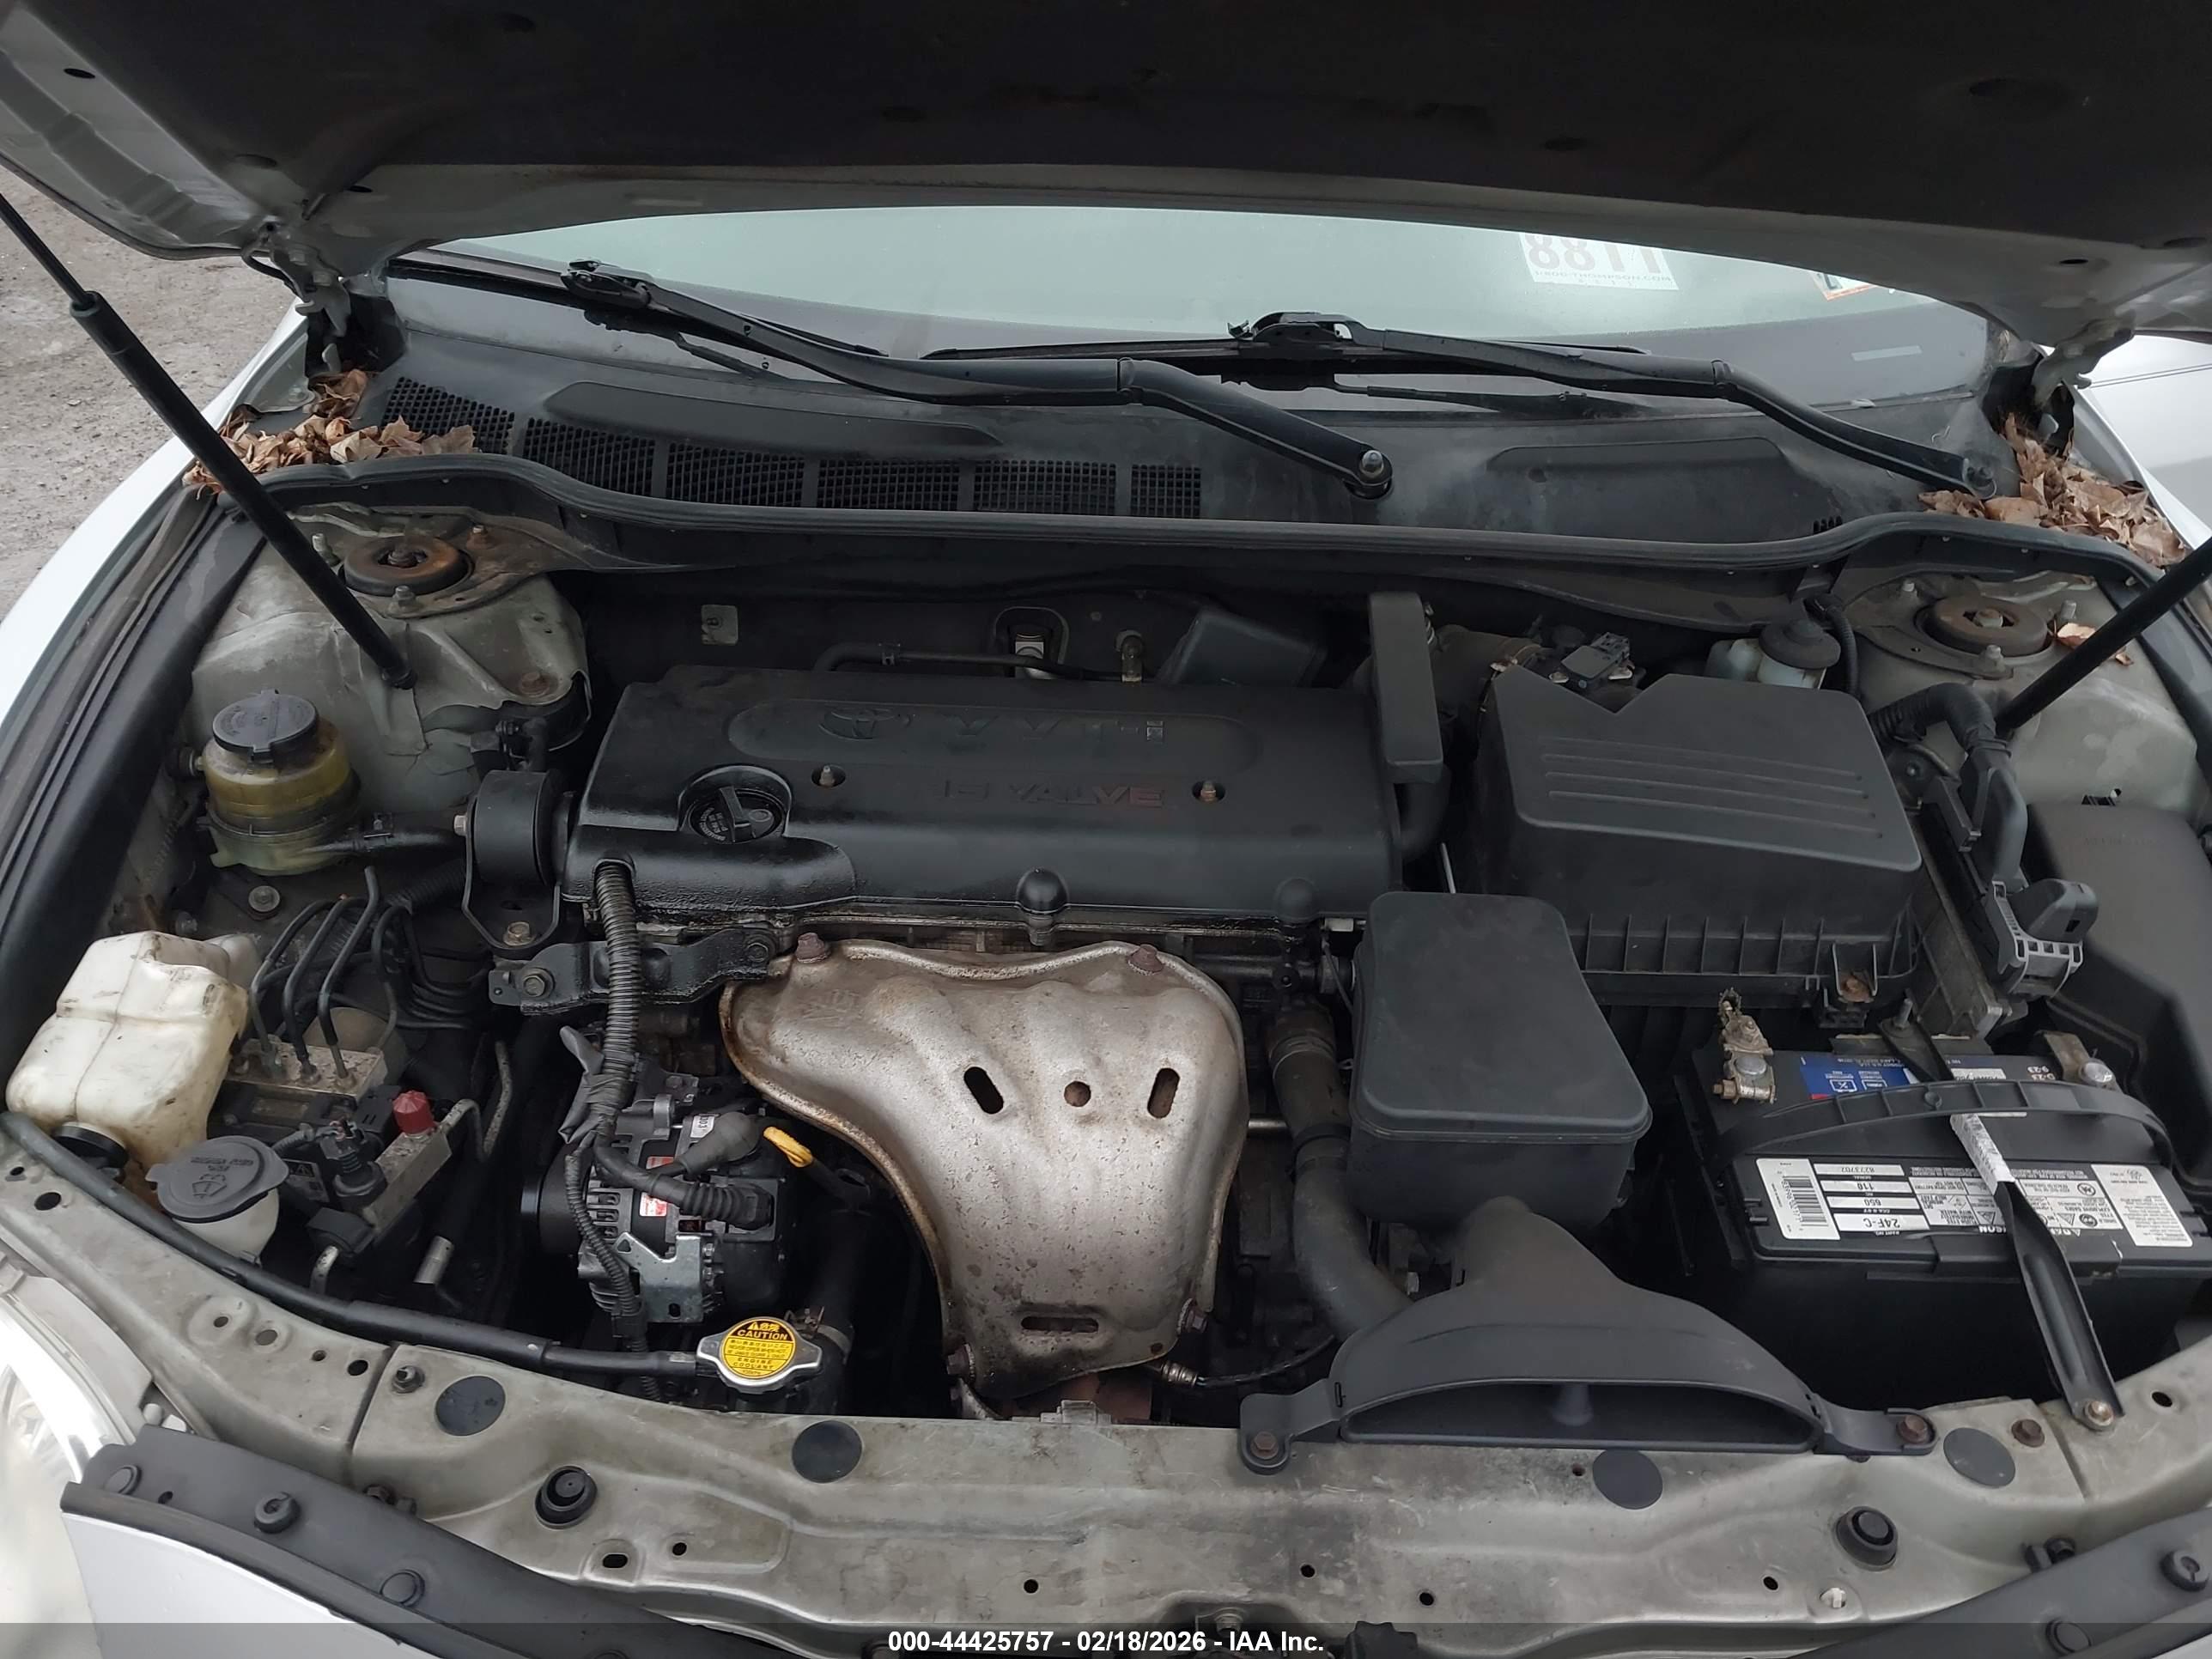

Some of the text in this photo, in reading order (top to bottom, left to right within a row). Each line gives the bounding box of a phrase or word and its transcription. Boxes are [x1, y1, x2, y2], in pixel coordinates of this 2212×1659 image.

[1856, 1182, 1875, 1190] 110
[1863, 1217, 1901, 1229] 24F-C
[737, 1329, 788, 1340] CAUTION
